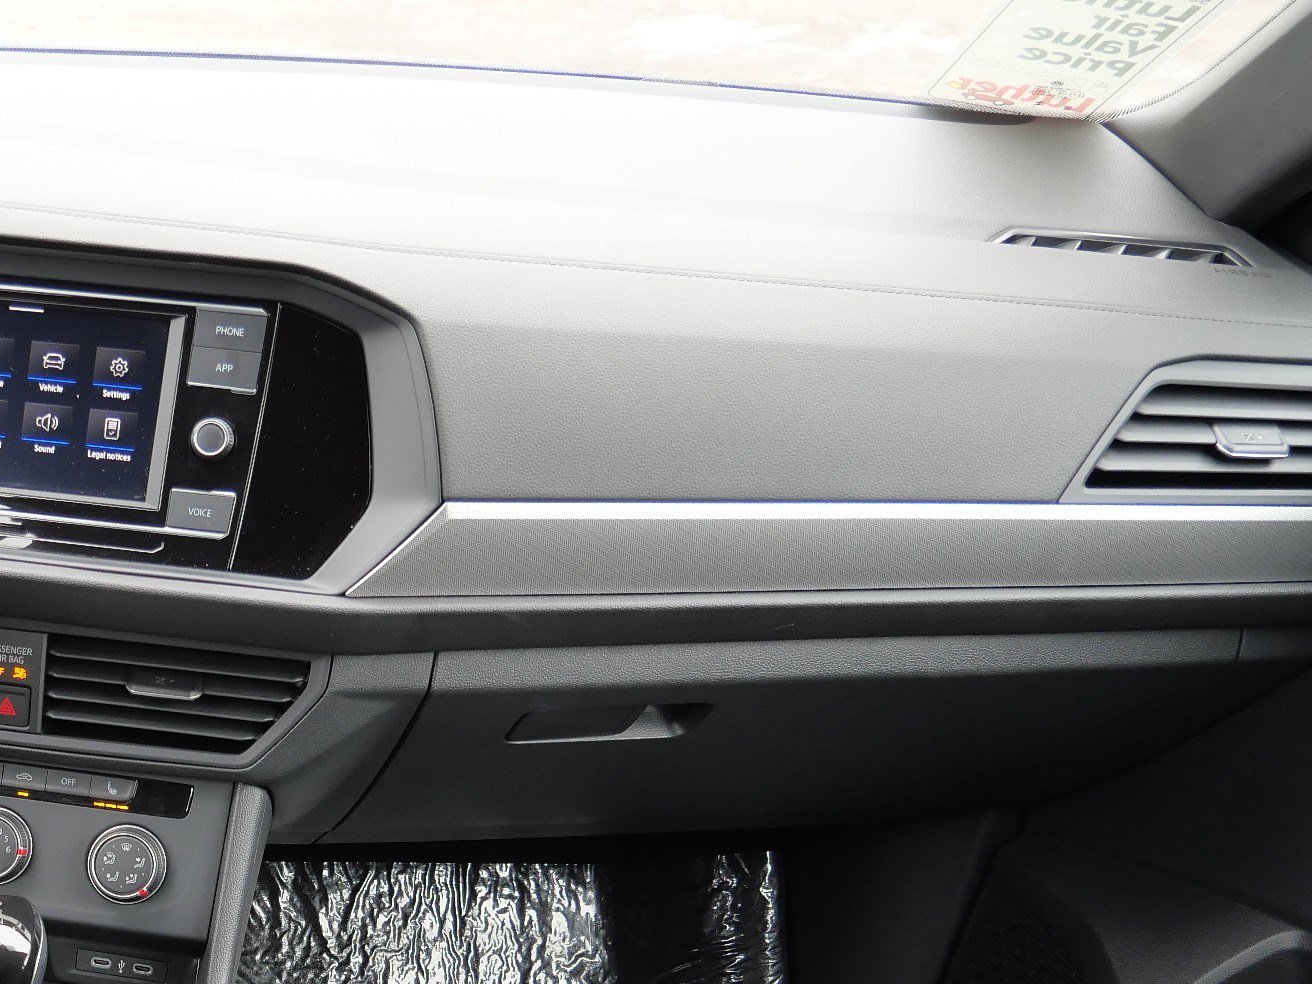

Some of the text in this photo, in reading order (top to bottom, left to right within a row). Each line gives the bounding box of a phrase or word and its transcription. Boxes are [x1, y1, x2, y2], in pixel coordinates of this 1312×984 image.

[215, 325, 245, 337] PHONE
[215, 363, 234, 373] APP
[39, 383, 63, 394] Vehicle
[102, 389, 130, 400] Settings
[34, 444, 55, 454] Sound
[88, 450, 131, 462] Legal notices
[188, 508, 213, 518] VOICE
[8, 655, 25, 665] BAG
[61, 777, 76, 786] OFF
